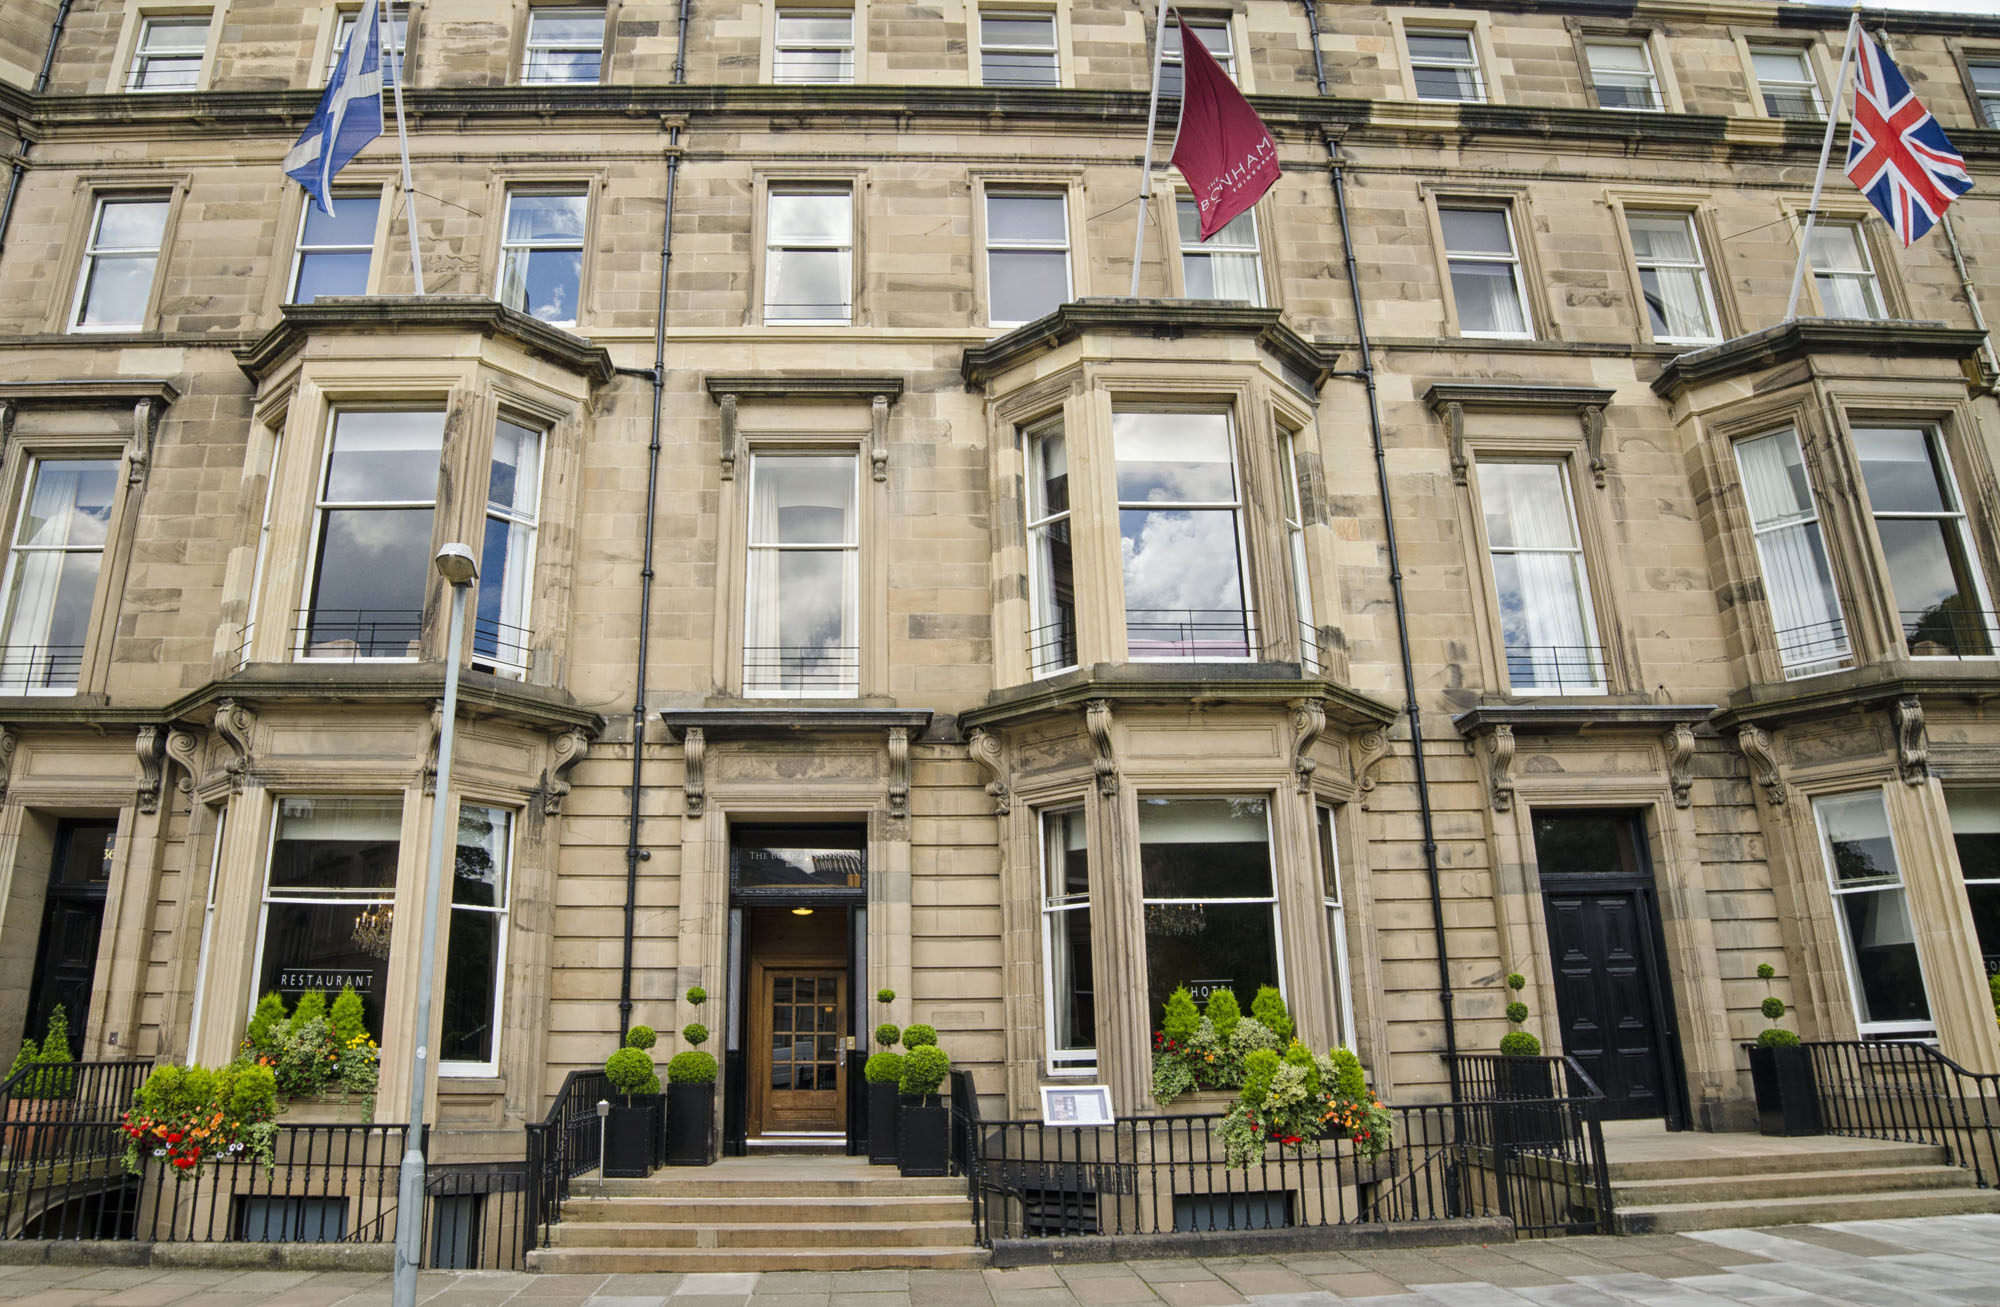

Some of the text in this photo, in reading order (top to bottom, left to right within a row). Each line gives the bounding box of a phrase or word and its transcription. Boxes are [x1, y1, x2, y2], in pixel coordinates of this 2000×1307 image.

[1200, 136, 1271, 212] BONHAM
[1232, 151, 1275, 193] EDINBURGH
[103, 848, 115, 860] 36
[749, 851, 768, 860] THE
[281, 974, 373, 986] RESTAURANT
